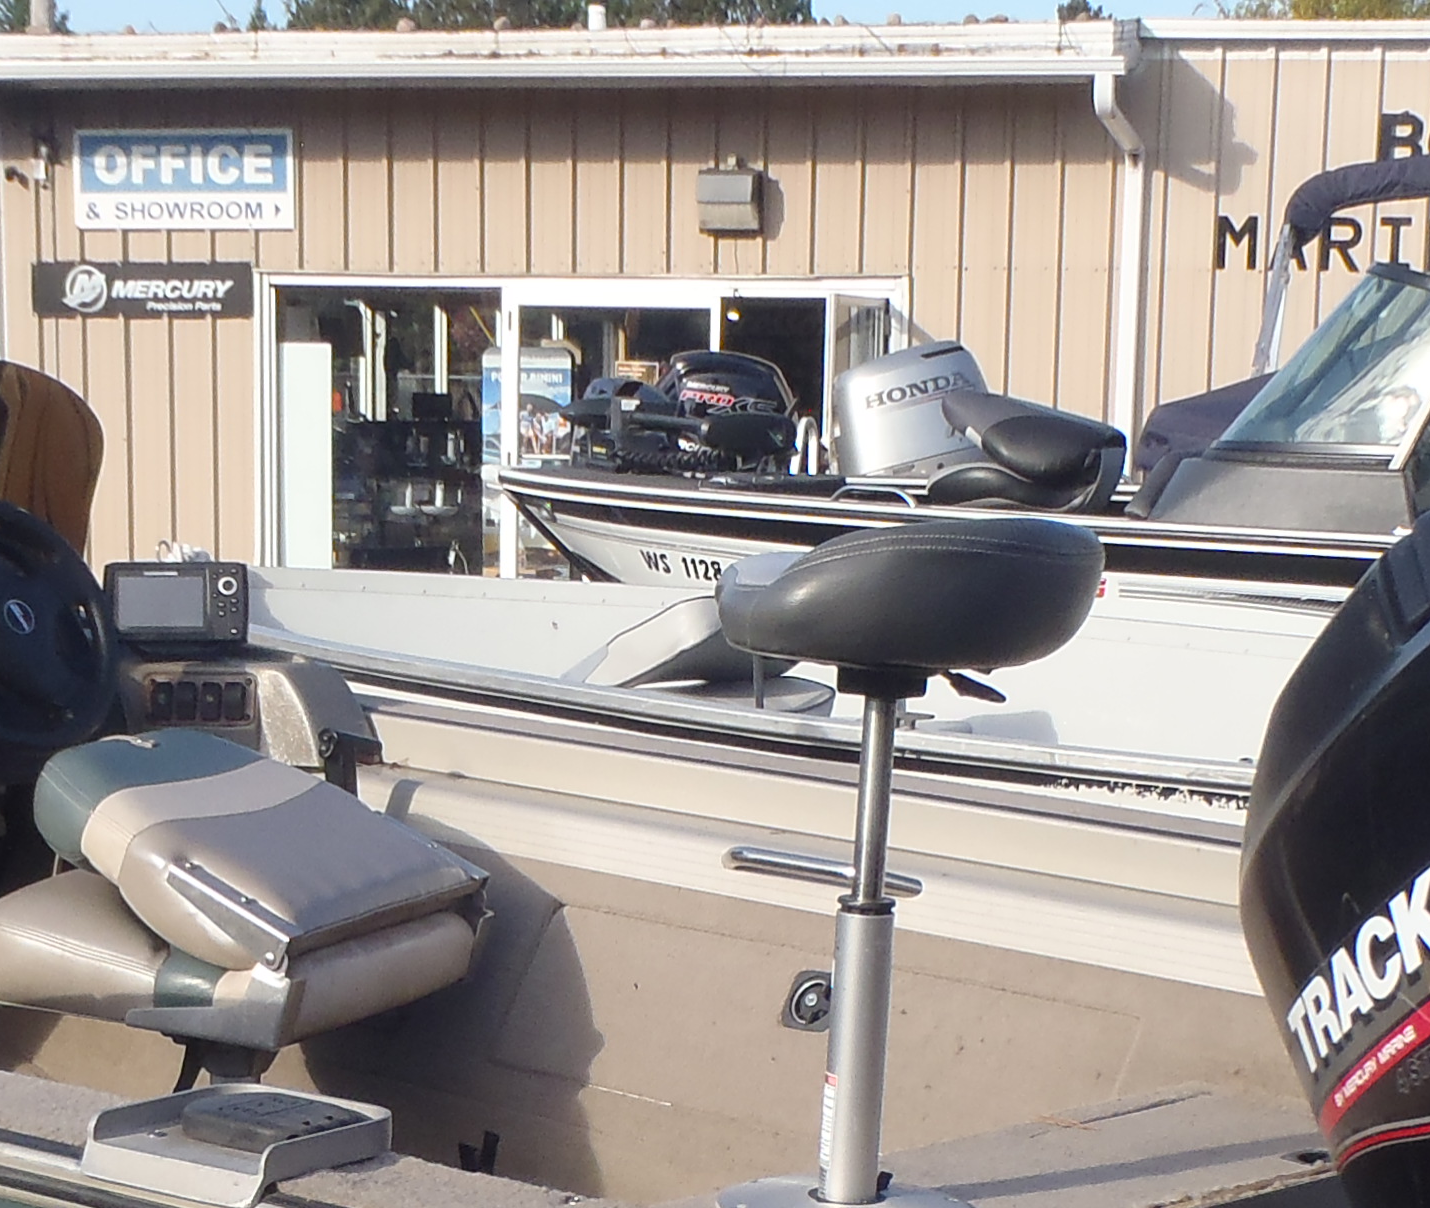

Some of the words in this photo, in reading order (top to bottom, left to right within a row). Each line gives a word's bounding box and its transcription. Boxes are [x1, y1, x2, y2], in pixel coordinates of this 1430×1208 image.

[94, 144, 274, 186] OFFICE
[86, 202, 101, 220] &
[115, 201, 263, 220] SHOWROOM
[111, 280, 234, 299] MERCURY
[146, 301, 193, 312] Precision
[194, 301, 222, 312] Parts
[865, 372, 974, 409] HONDA
[639, 549, 671, 574] WS
